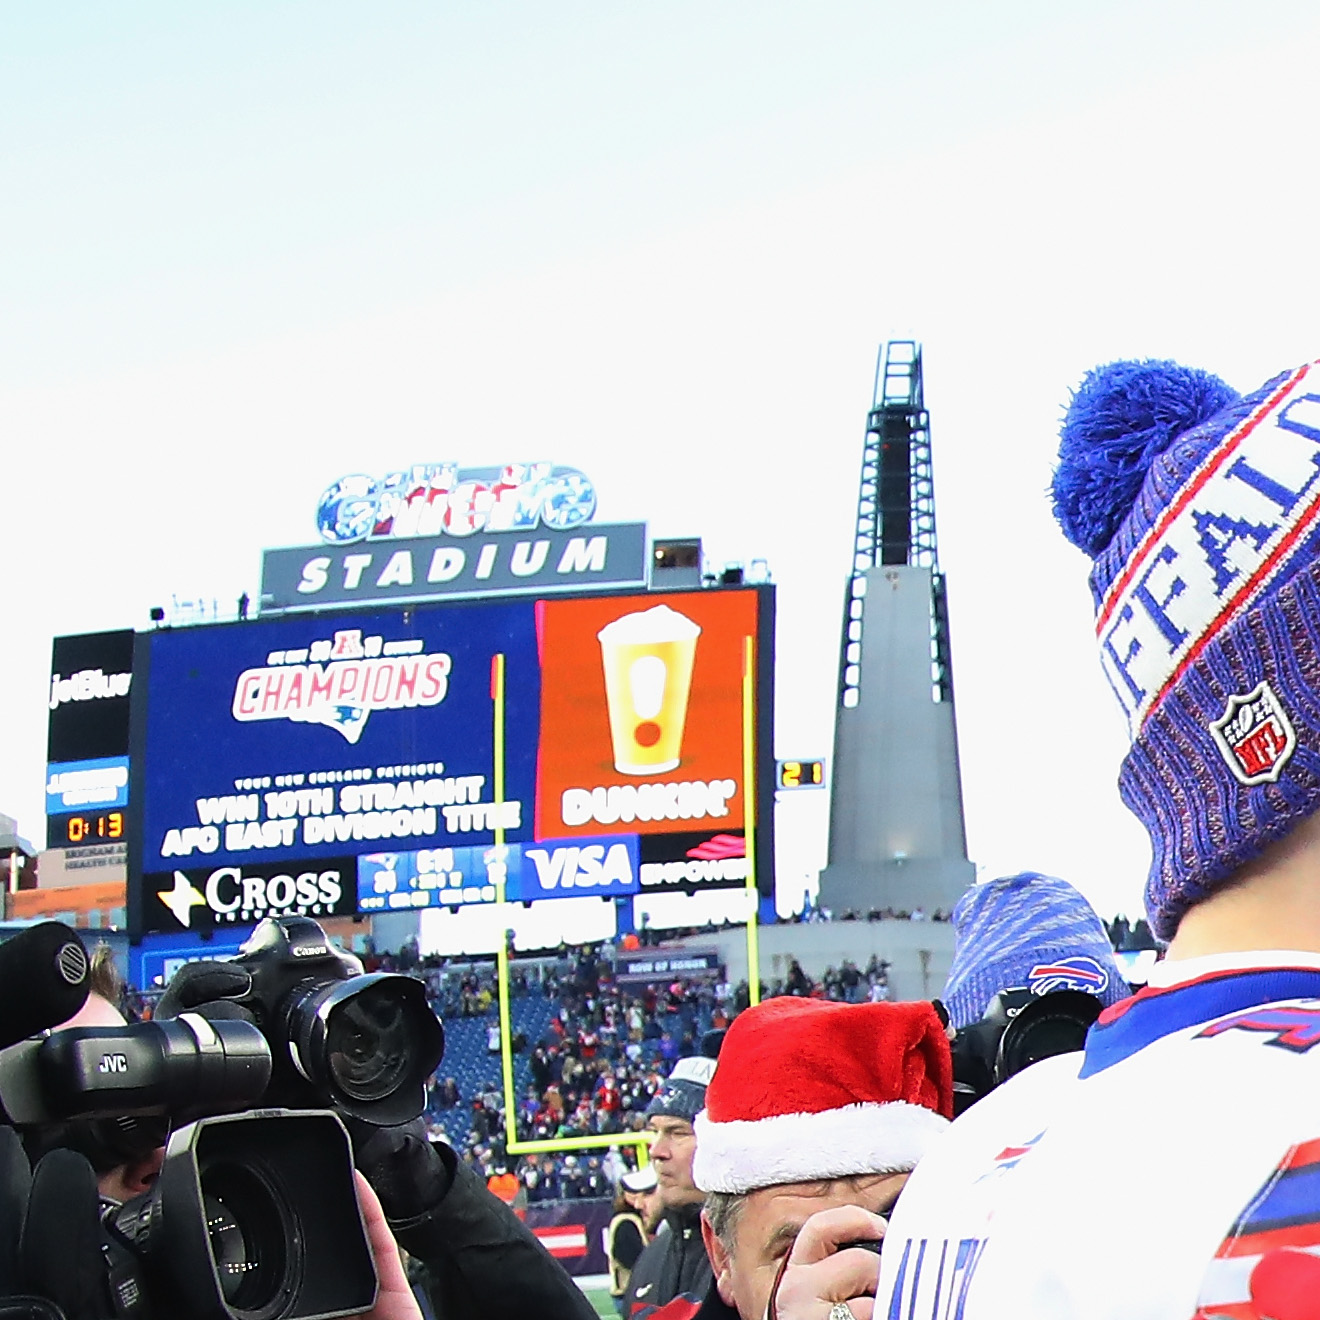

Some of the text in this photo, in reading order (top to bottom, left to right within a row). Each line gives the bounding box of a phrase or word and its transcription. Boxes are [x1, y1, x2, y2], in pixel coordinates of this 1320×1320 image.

[297, 536, 608, 594] STADIUM
[50, 668, 133, 709] jetBlue
[237, 659, 447, 714] CHAMPIONS
[1233, 721, 1288, 776] NFL
[196, 775, 486, 825] WIN 10TH STRAIGHT
[67, 813, 124, 842] 0:13
[160, 827, 219, 857] AFC
[225, 818, 298, 850] EAST
[303, 808, 437, 844] DIVISION
[525, 843, 634, 889] VISA
[293, 945, 327, 957] Canon
[100, 1054, 127, 1073] JVC
